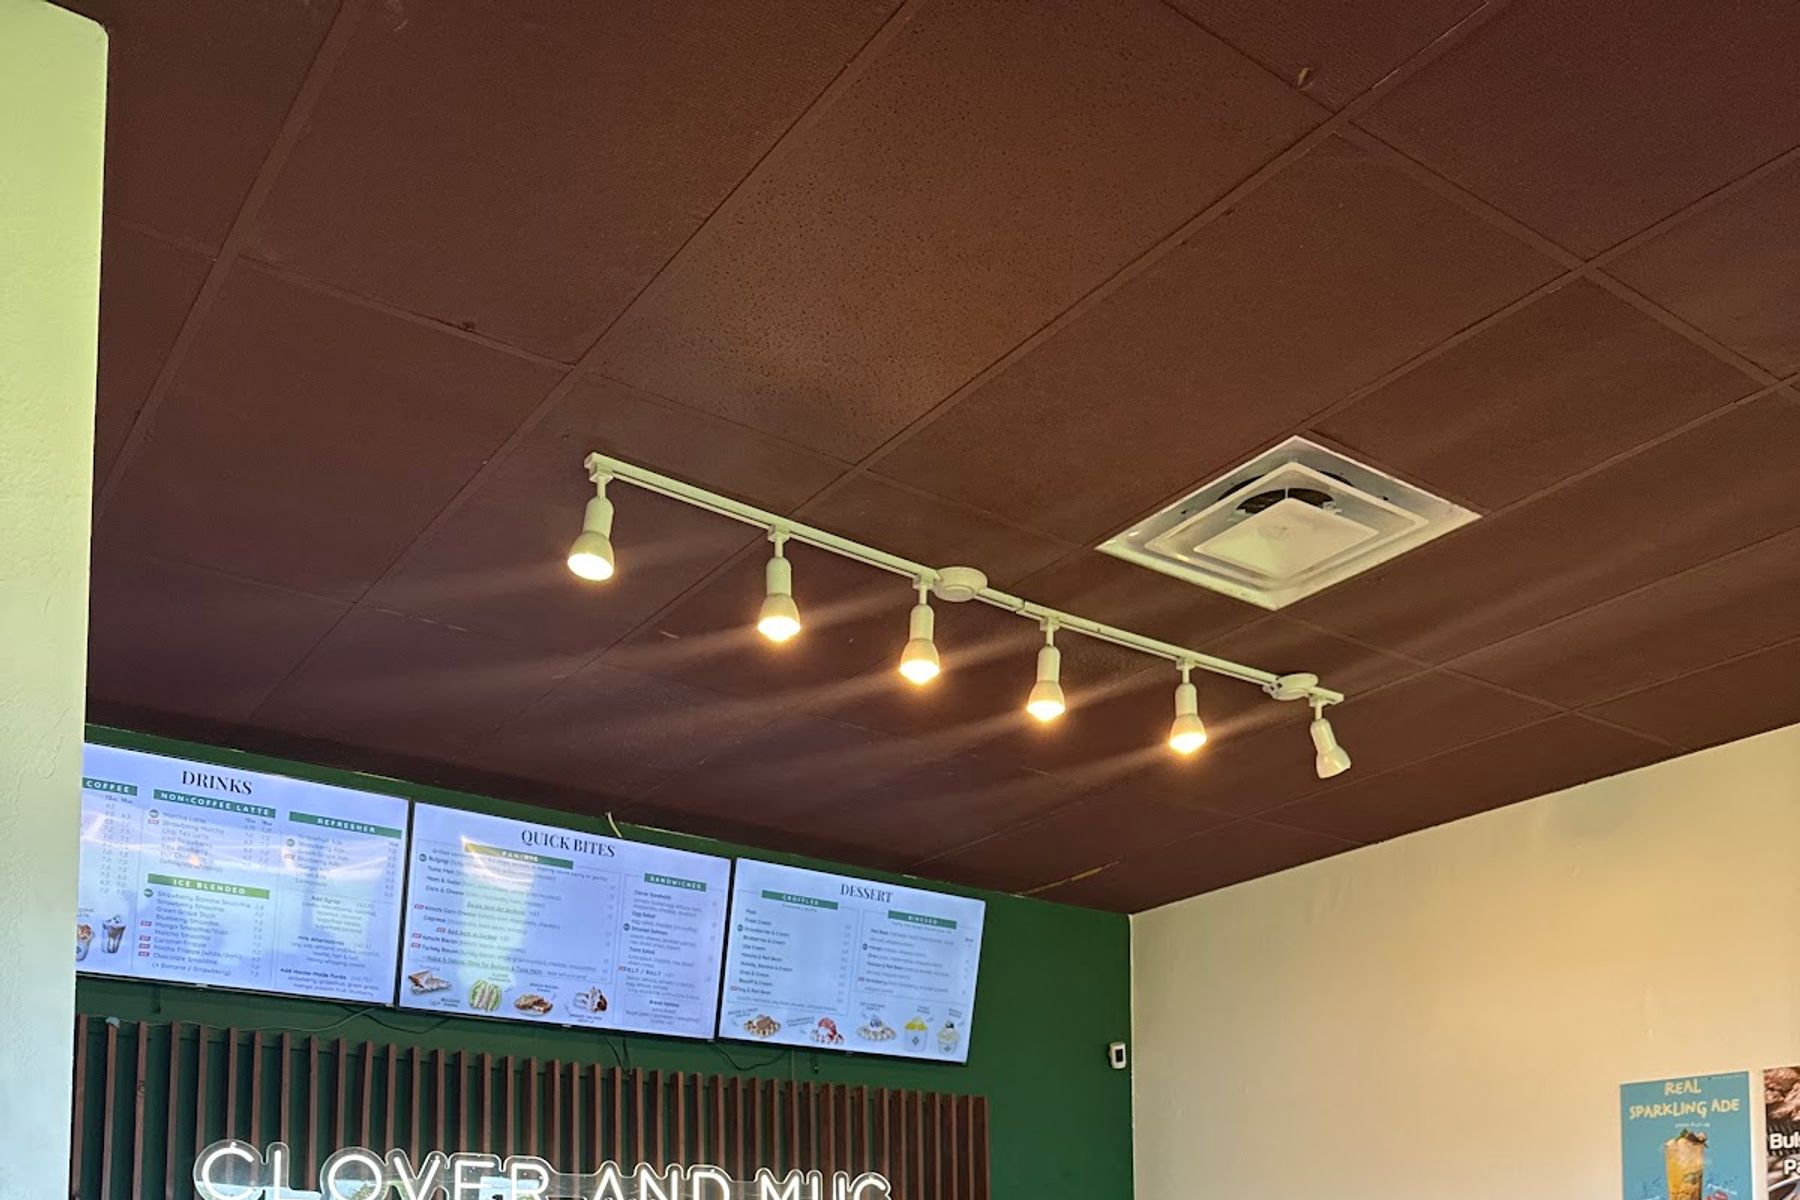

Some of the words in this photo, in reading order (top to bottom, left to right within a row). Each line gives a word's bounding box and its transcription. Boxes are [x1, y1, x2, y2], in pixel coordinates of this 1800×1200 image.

[86, 780, 130, 793] COFFEE
[182, 770, 253, 795] DRINKS
[160, 792, 231, 810] NON-COFFEE
[236, 804, 270, 816] LATTE
[317, 818, 376, 834] REFRESHER
[521, 829, 570, 850] QUICK
[573, 838, 615, 858] BITES
[173, 879, 191, 888] ICE
[197, 882, 246, 895] BLENDED
[841, 883, 893, 904] DESSERT
[1664, 1079, 1701, 1096] REAL
[1629, 1101, 1707, 1119] SPARKLING
[1711, 1098, 1740, 1113] ADE
[1770, 1131, 1800, 1149] Bul
